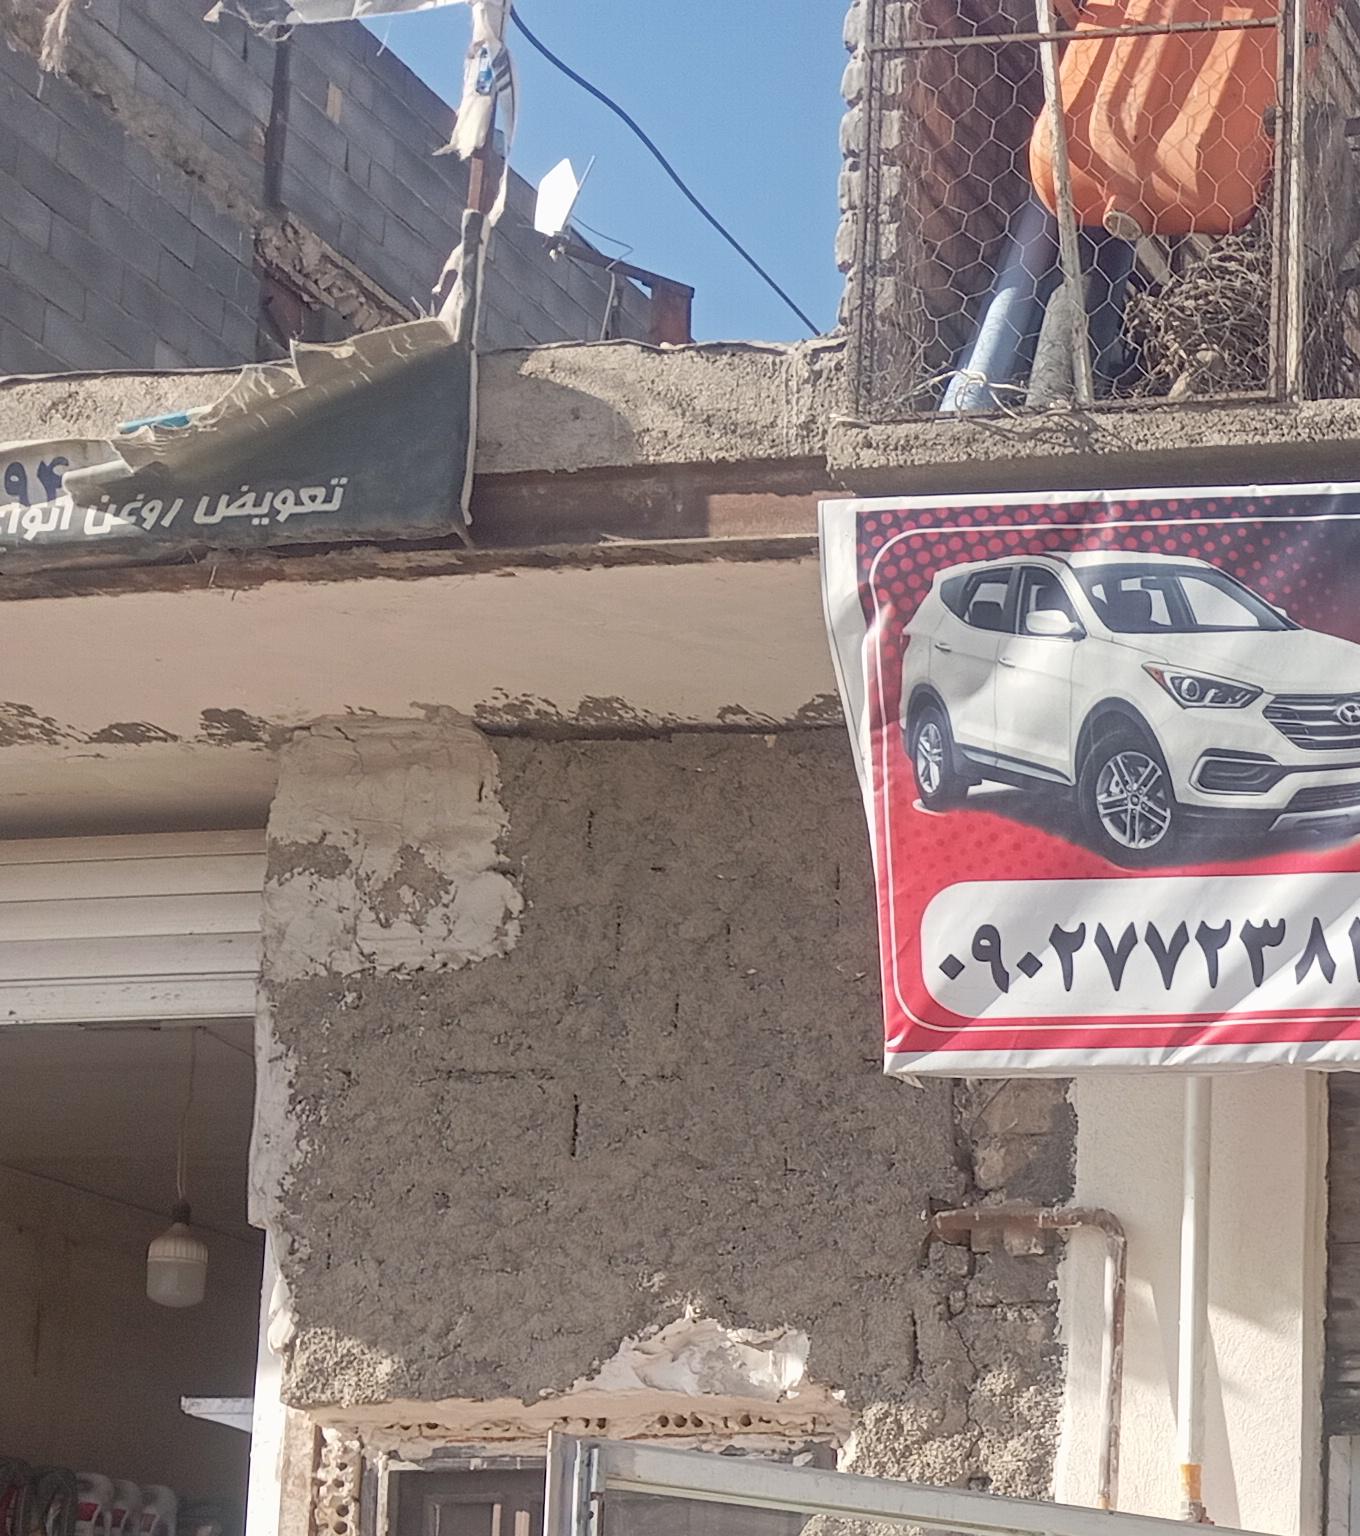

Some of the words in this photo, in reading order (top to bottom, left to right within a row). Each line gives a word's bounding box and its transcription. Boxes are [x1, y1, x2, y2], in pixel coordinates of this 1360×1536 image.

[0, 495, 75, 541] انوا
[84, 494, 184, 535] روغن
[193, 477, 348, 525] تعویض
